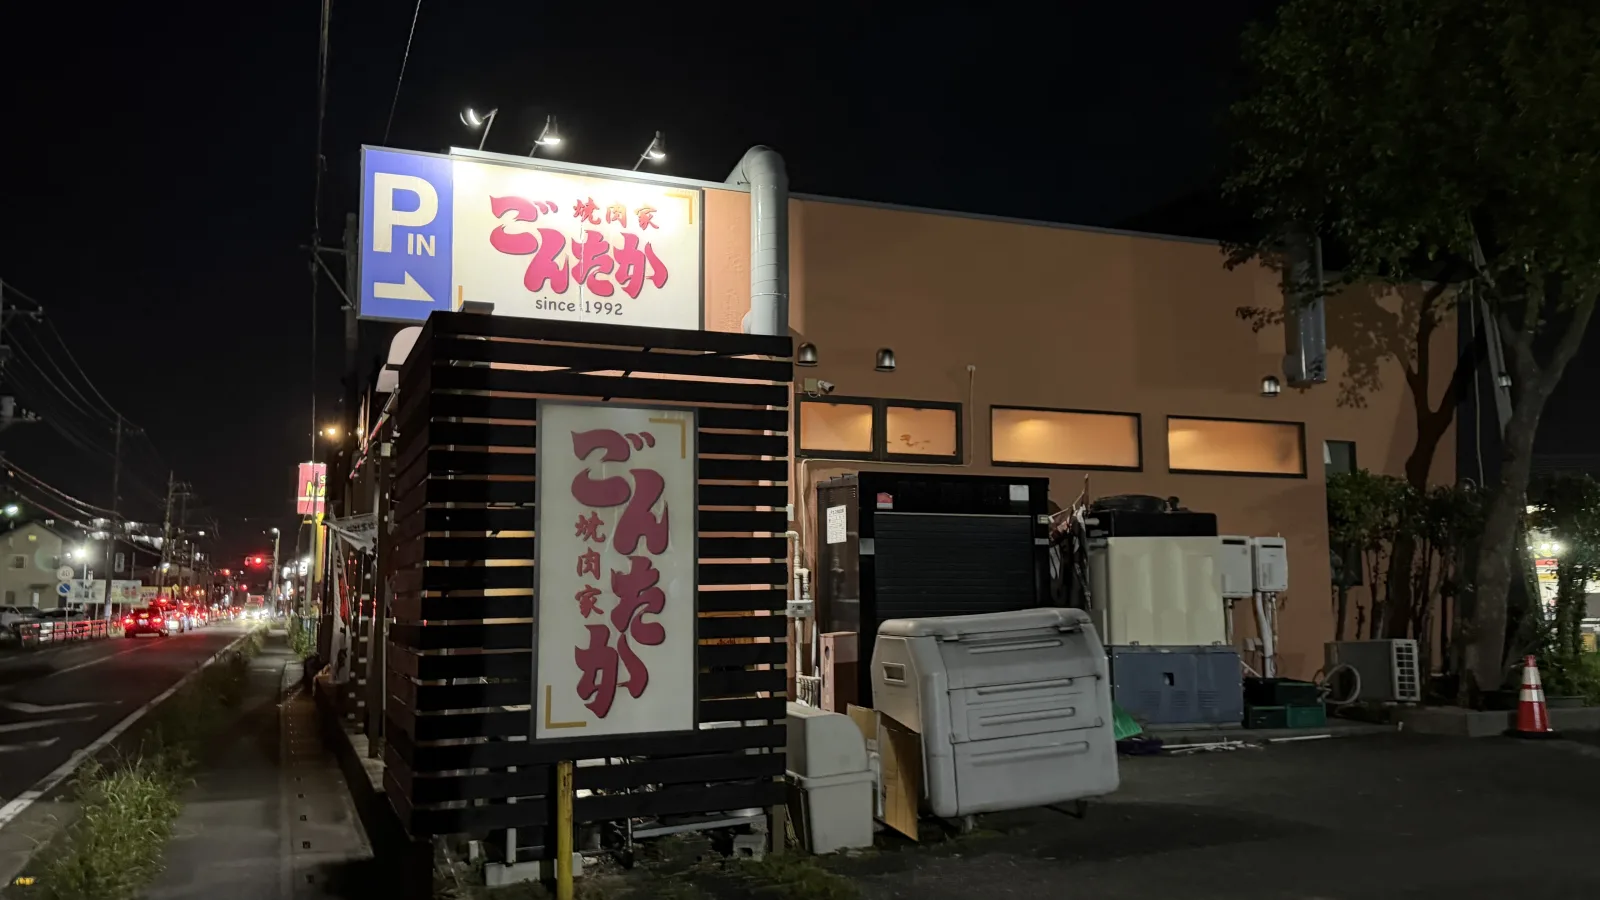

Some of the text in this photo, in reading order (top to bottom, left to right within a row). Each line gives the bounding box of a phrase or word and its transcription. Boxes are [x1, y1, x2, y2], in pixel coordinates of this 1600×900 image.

[372, 172, 439, 254] P
[407, 232, 436, 257] IN
[489, 194, 669, 300] ごんたか
[572, 196, 660, 231] 焼肉家
[535, 297, 623, 316] since 1992
[570, 428, 671, 719] ごんたか
[574, 511, 606, 618] 焼肉家
